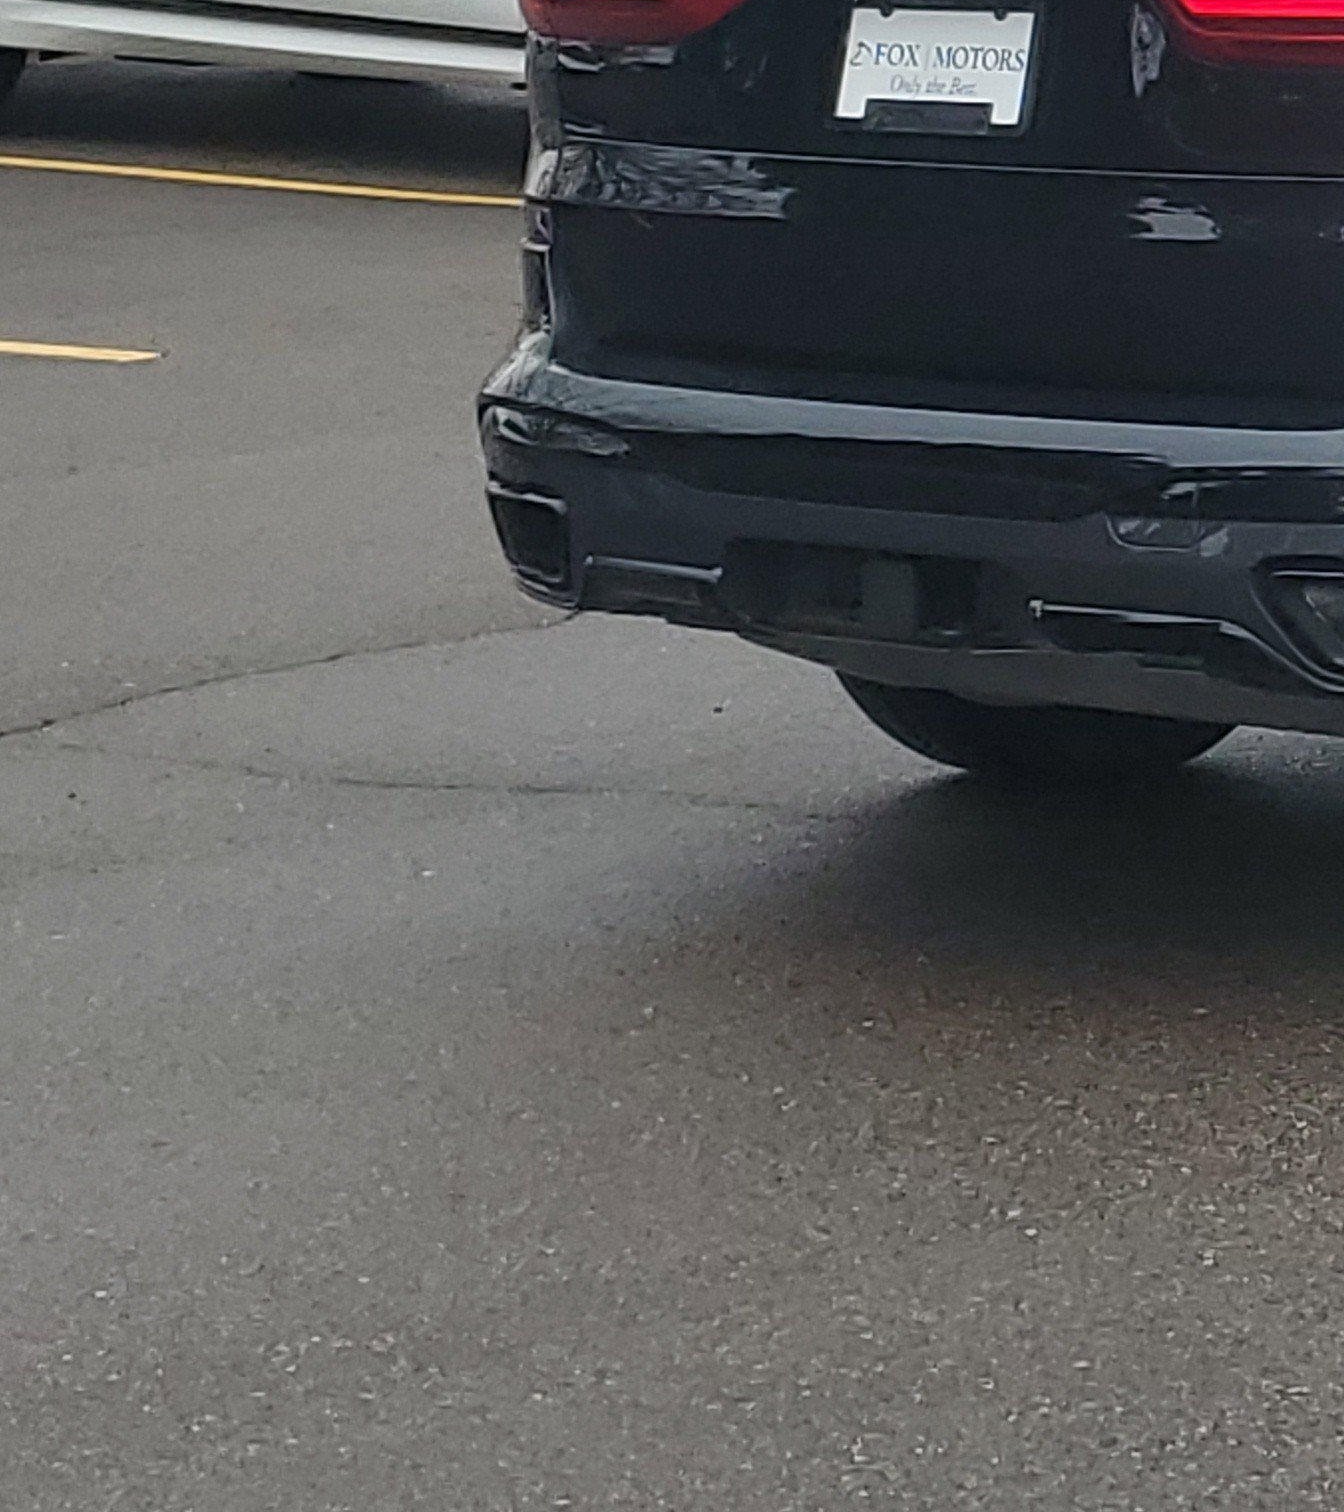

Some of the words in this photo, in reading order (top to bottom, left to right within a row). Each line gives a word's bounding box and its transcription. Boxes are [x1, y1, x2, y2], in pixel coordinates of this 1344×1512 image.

[874, 42, 920, 68] FOX
[932, 45, 1026, 72] MOTORS
[890, 74, 922, 97] Only
